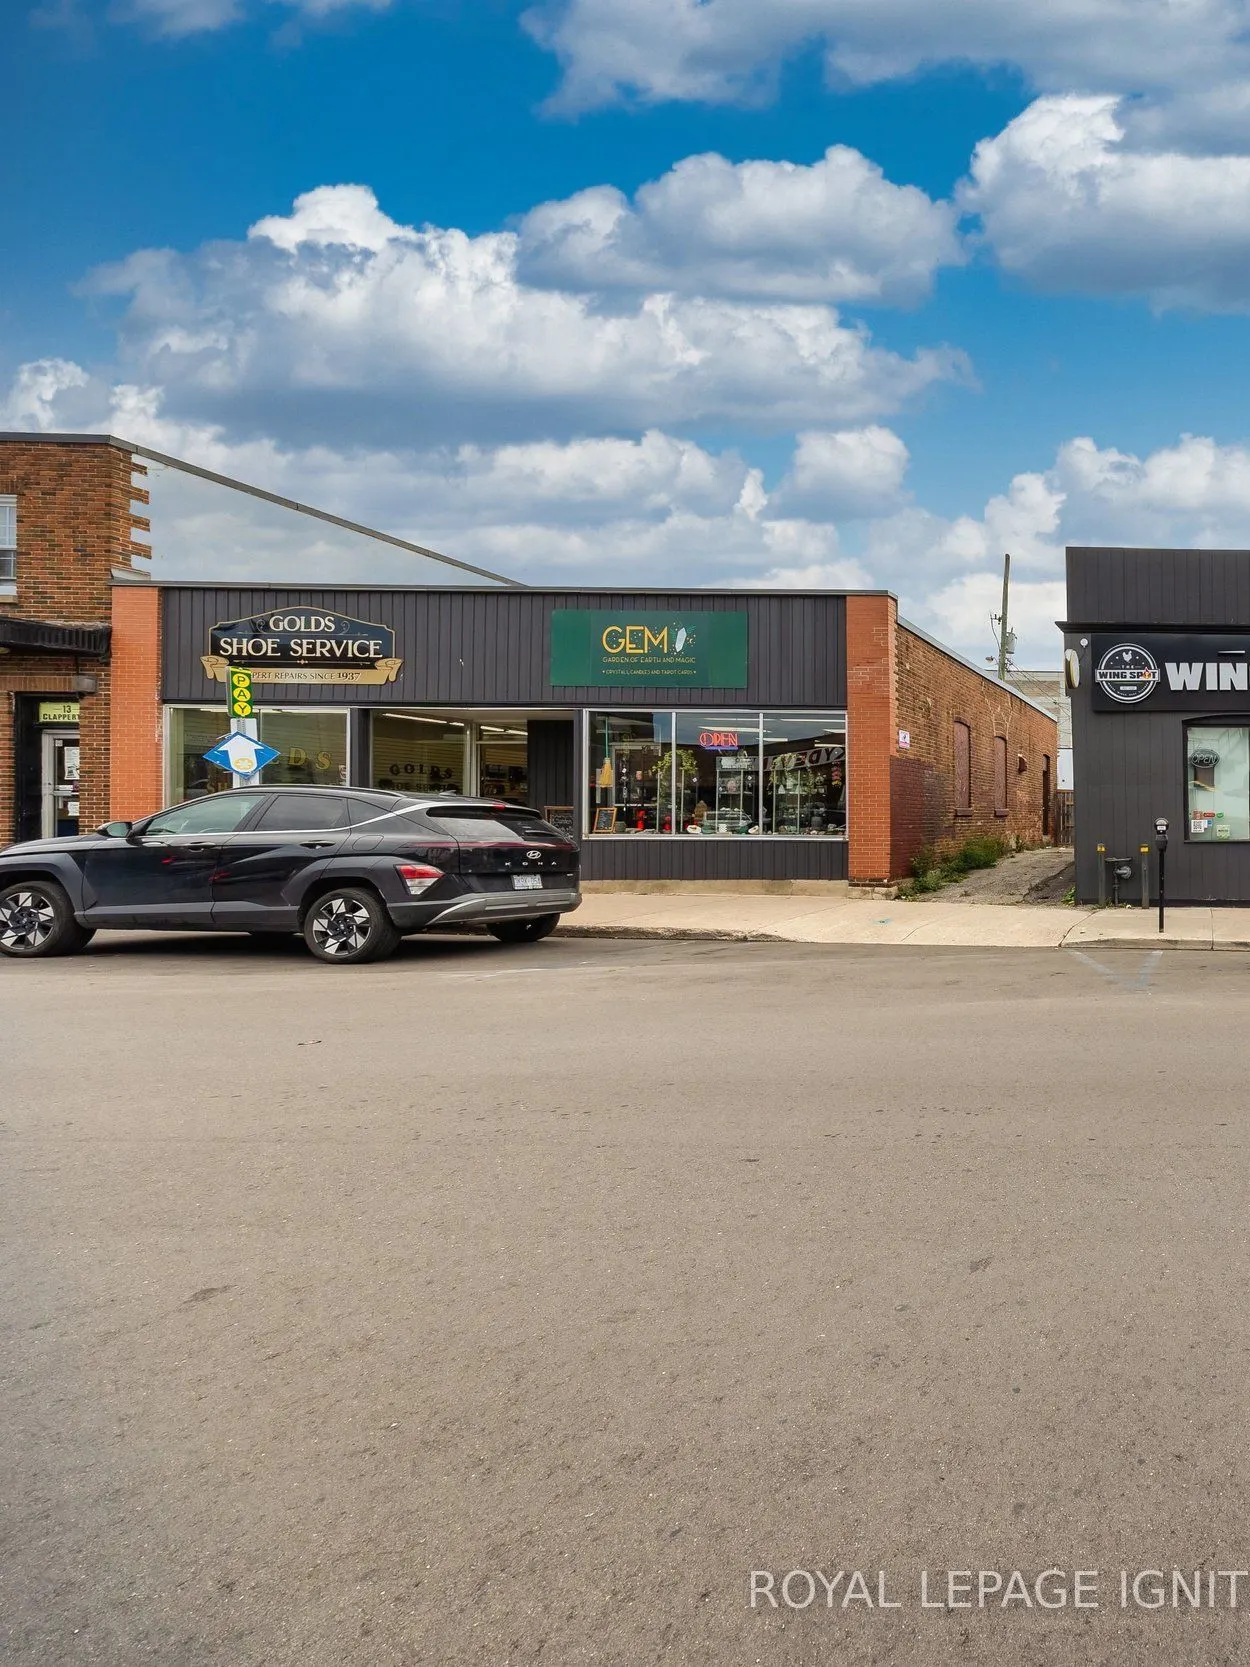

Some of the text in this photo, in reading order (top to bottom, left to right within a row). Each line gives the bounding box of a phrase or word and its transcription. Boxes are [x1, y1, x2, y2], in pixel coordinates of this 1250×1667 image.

[269, 615, 336, 632] GOLDS
[602, 625, 668, 654] GEM
[219, 638, 383, 658] SHOE SERVICE
[274, 672, 309, 680] REPAIRS
[337, 672, 360, 681] 1937
[1098, 671, 1127, 679] WING
[62, 705, 72, 713] 13
[699, 732, 738, 748] OPEN
[1191, 753, 1217, 764] OPEN
